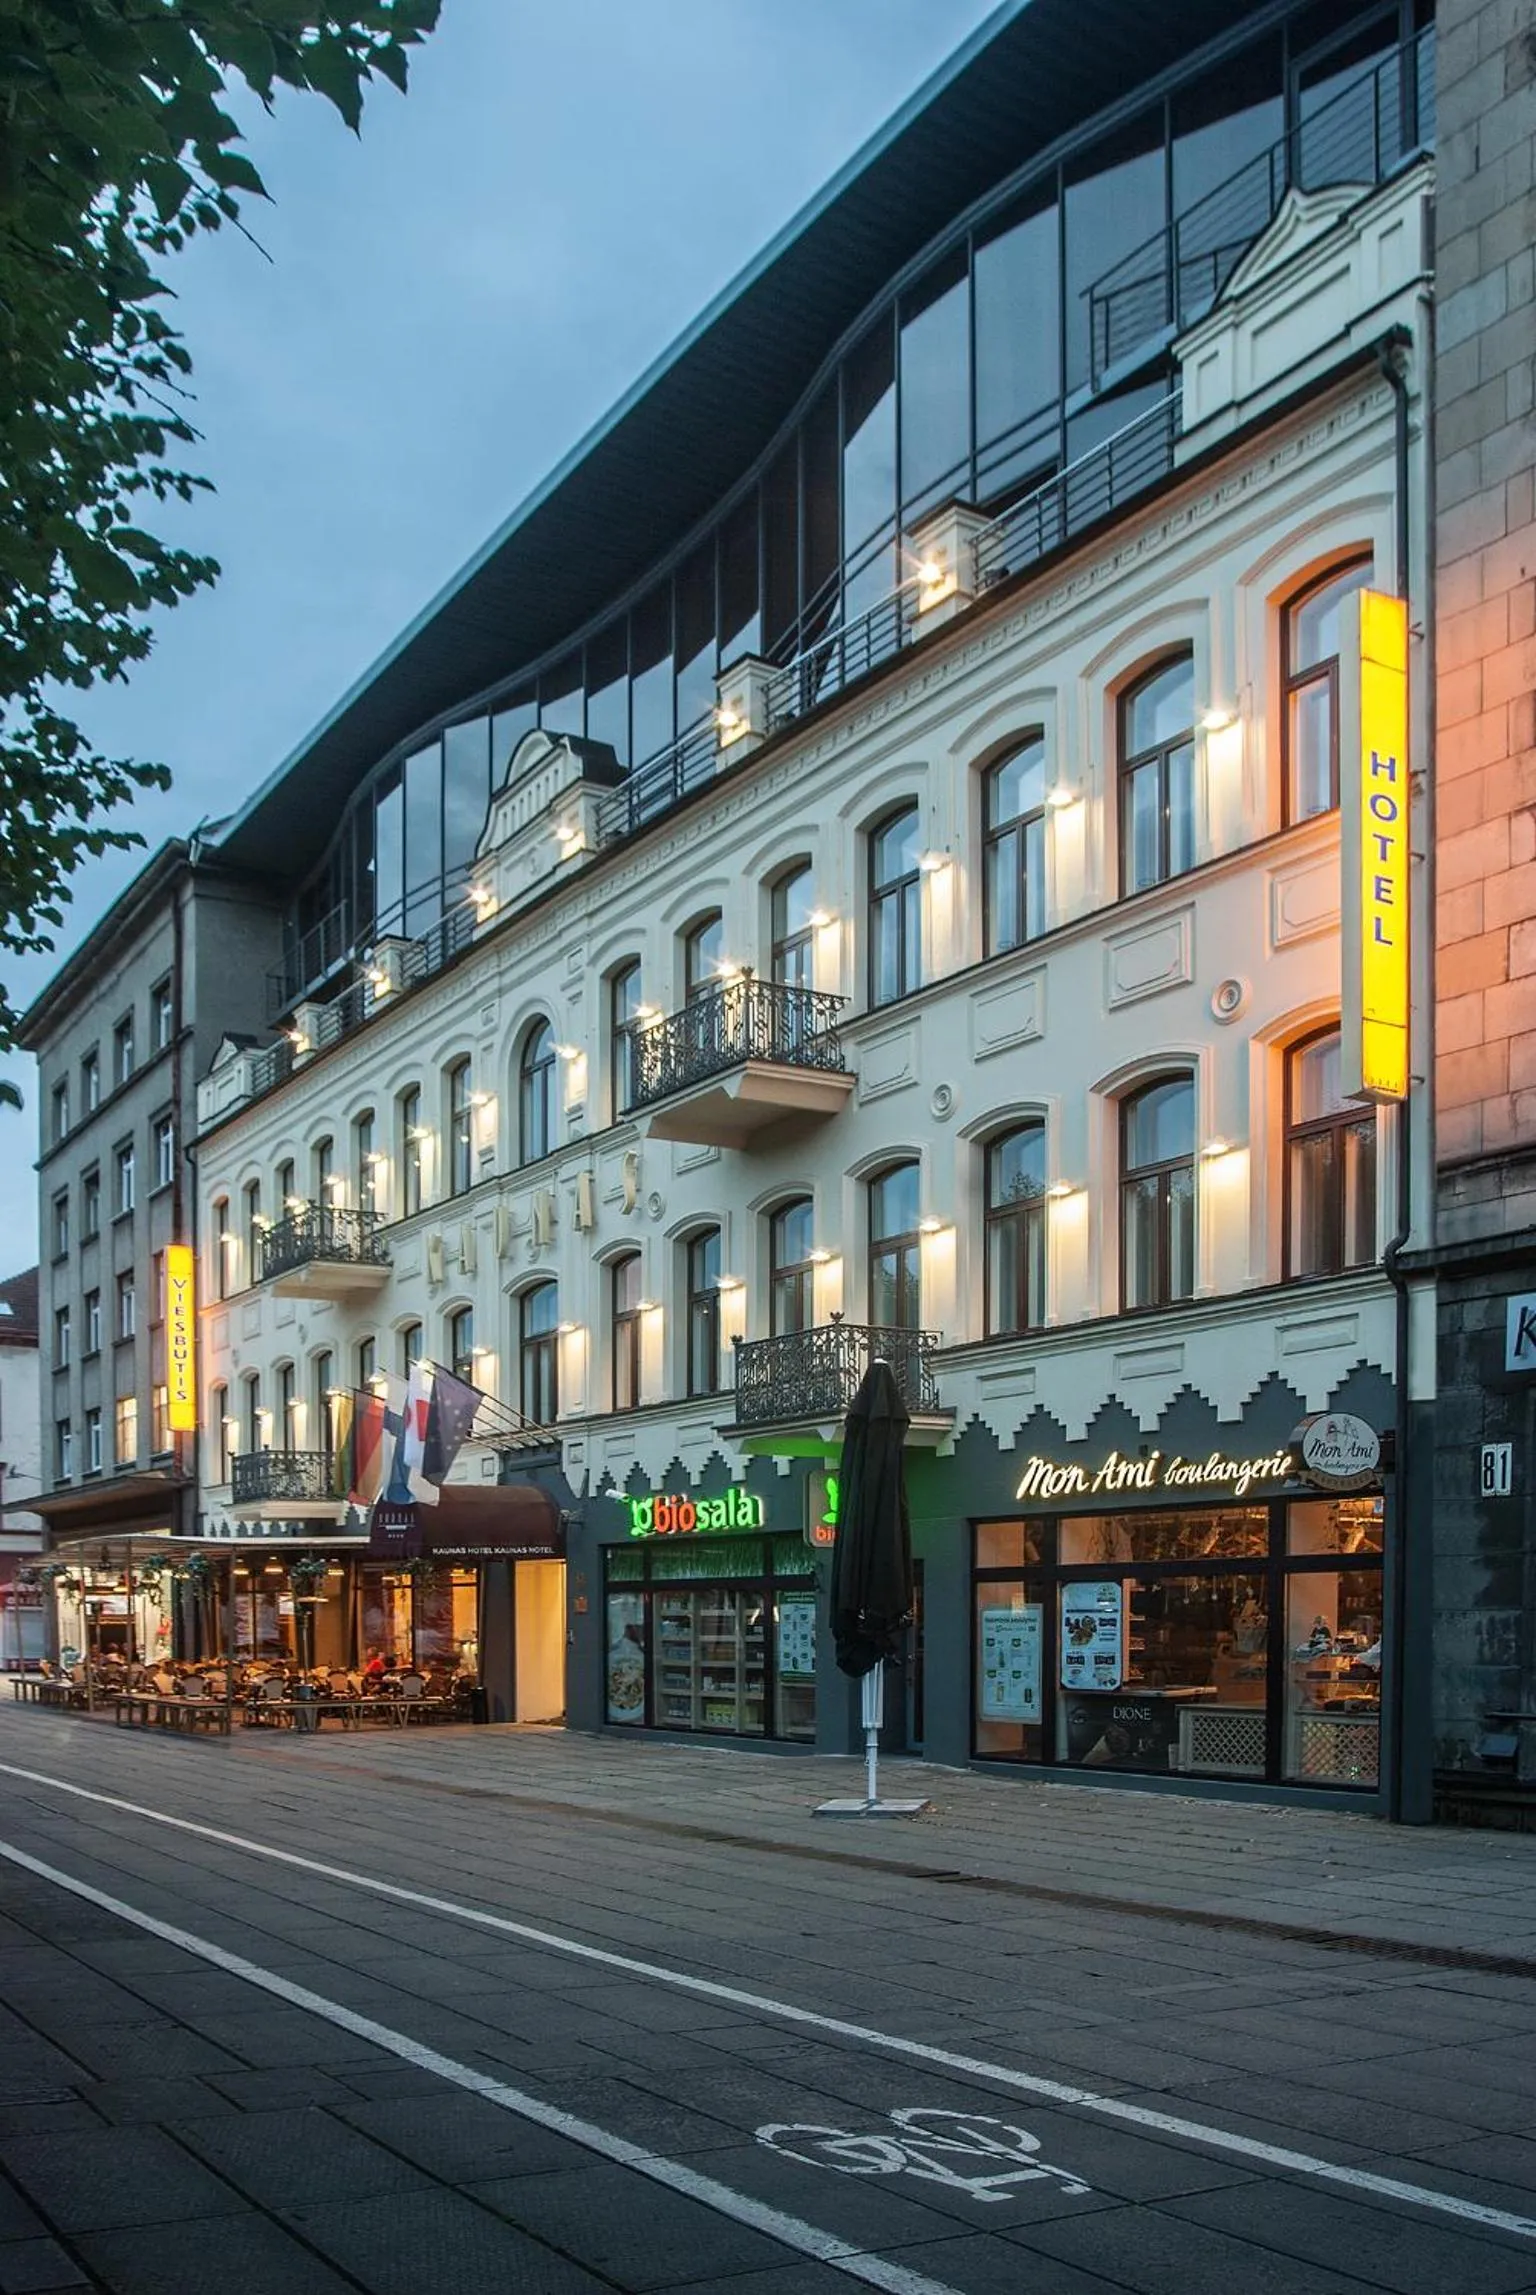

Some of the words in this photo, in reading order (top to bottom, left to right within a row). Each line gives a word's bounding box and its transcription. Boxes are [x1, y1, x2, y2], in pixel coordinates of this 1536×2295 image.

[1369, 750, 1398, 946] HOTEL
[172, 1278, 188, 1401] VIESBUTIS
[1307, 1438, 1341, 1459] Mon
[1346, 1441, 1375, 1459] Ami
[1015, 1455, 1089, 1500] Mon
[1091, 1450, 1161, 1493] Ami
[1163, 1449, 1293, 1496] boulangerie
[1482, 1450, 1508, 1490] 81
[653, 1487, 763, 1534] biosala
[432, 1546, 466, 1555] KAUNAS
[467, 1546, 493, 1554] HOTEL
[493, 1546, 528, 1554] KAUNAS
[528, 1545, 555, 1554] HOTEL
[815, 1525, 836, 1541] bi
[1112, 1706, 1153, 1721] DIONE
